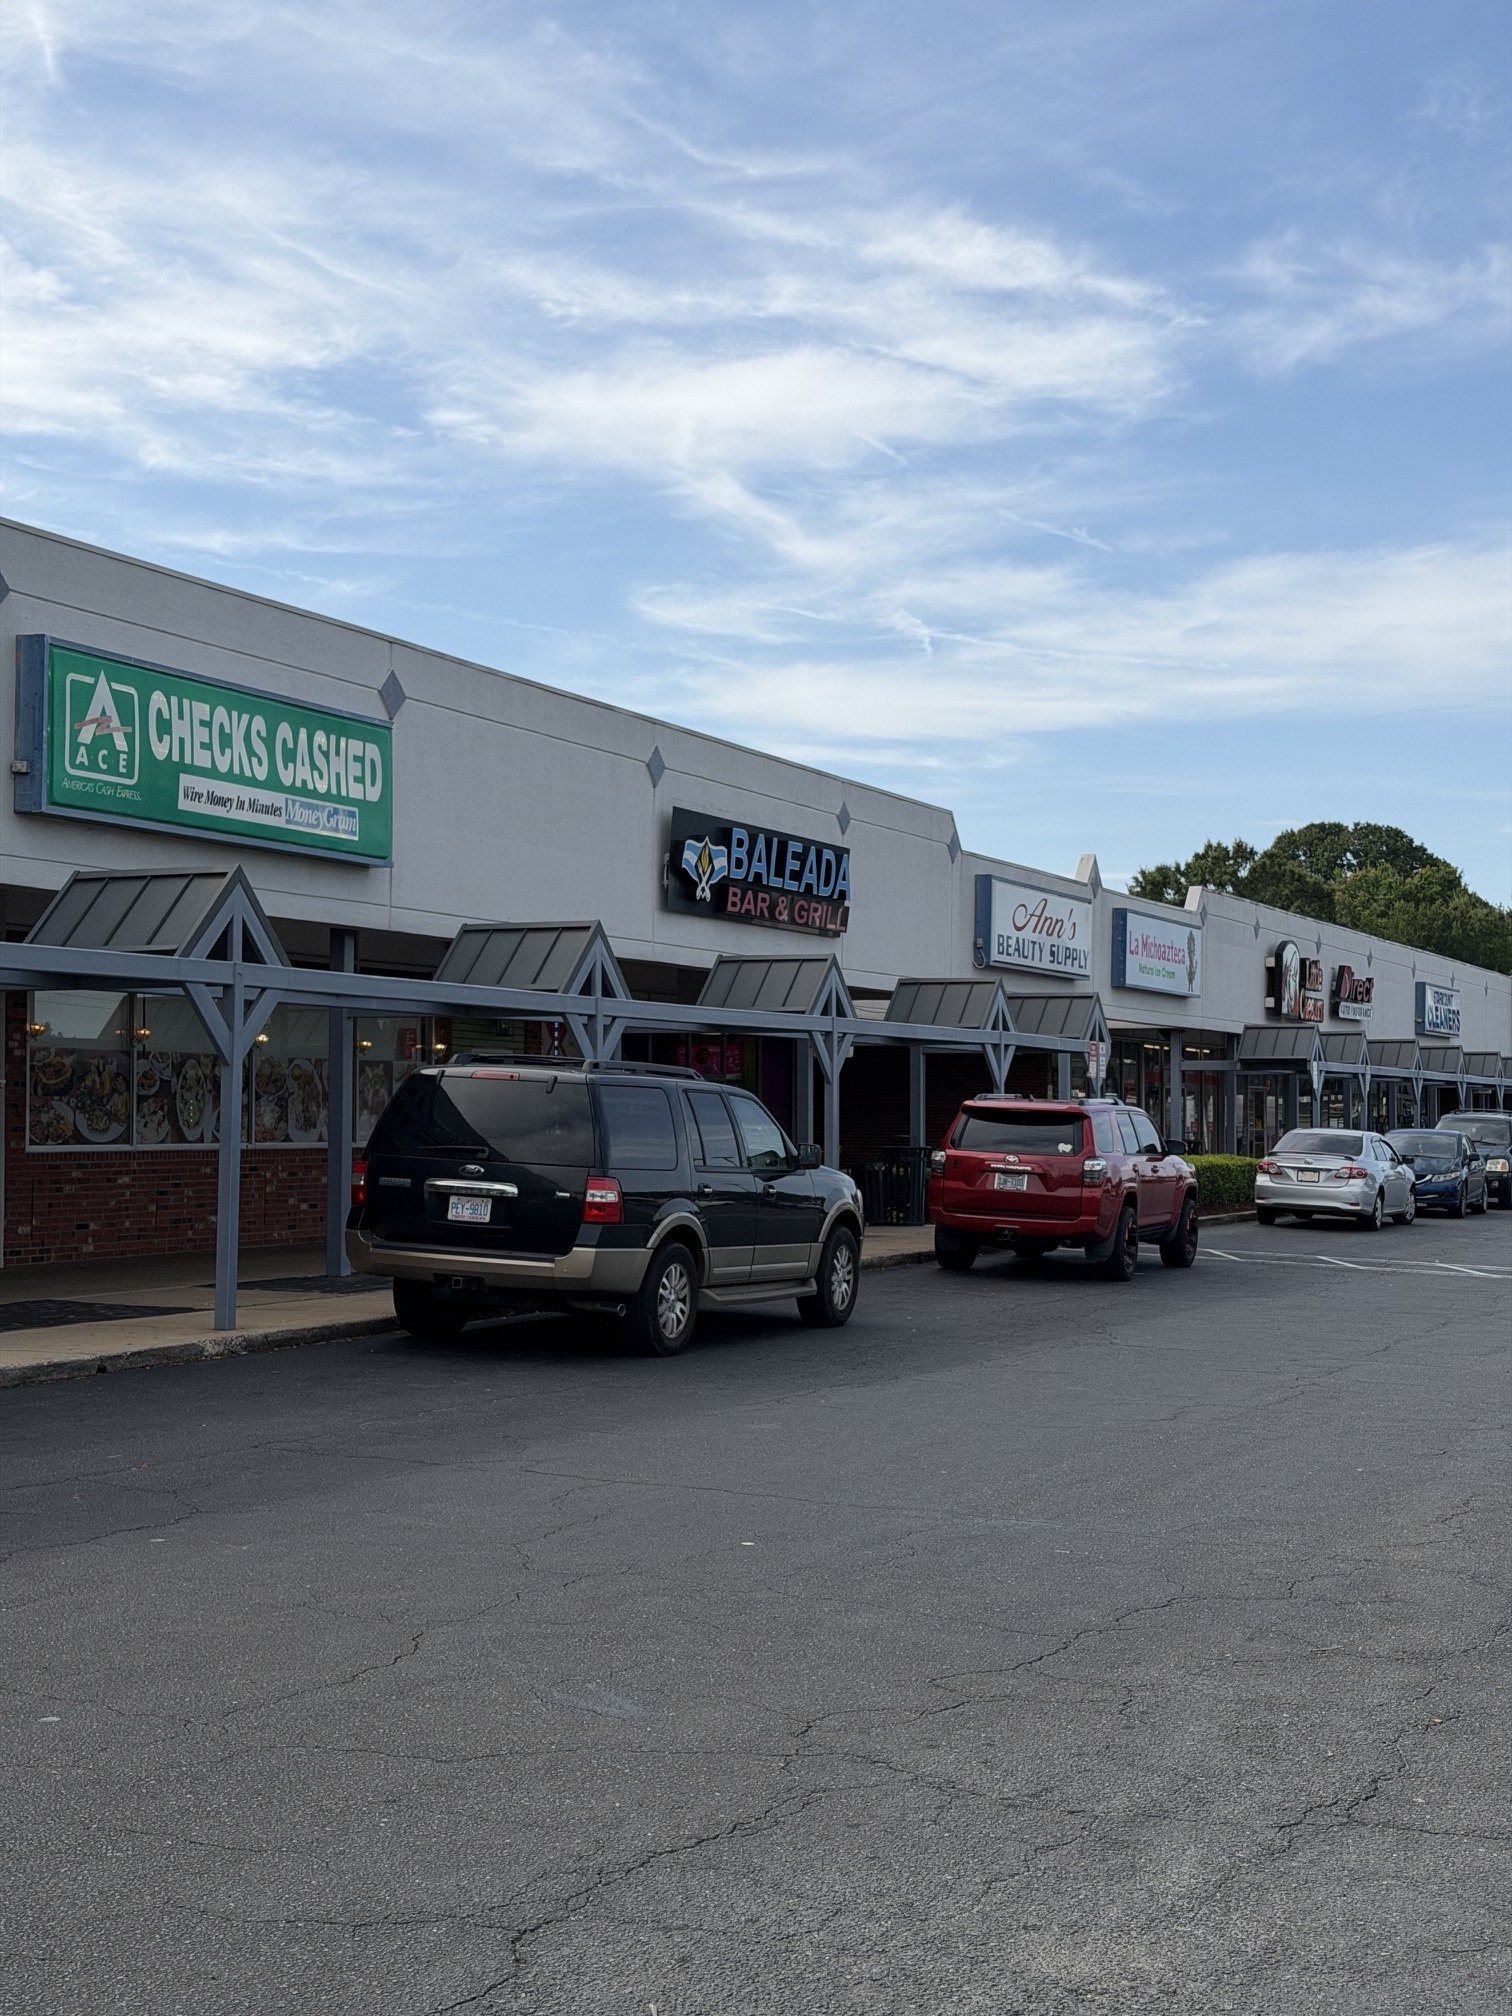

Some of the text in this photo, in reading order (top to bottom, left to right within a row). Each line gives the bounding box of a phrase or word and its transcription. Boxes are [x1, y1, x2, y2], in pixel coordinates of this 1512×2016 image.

[149, 690, 383, 802] CHECKS CASHED
[183, 785, 357, 832] Wire Money In Minutes MoneyGram
[729, 827, 850, 901] BALEADA
[727, 886, 846, 931] BAR & GRILL
[1012, 898, 1077, 941] Ann's
[997, 934, 1089, 970] BEAUTY SUPPLY
[1129, 931, 1186, 965] La Michoazteca
[1340, 967, 1374, 1003] Direct
[1428, 1005, 1460, 1032] CLEANERS
[450, 1202, 489, 1216] PEY-9810
